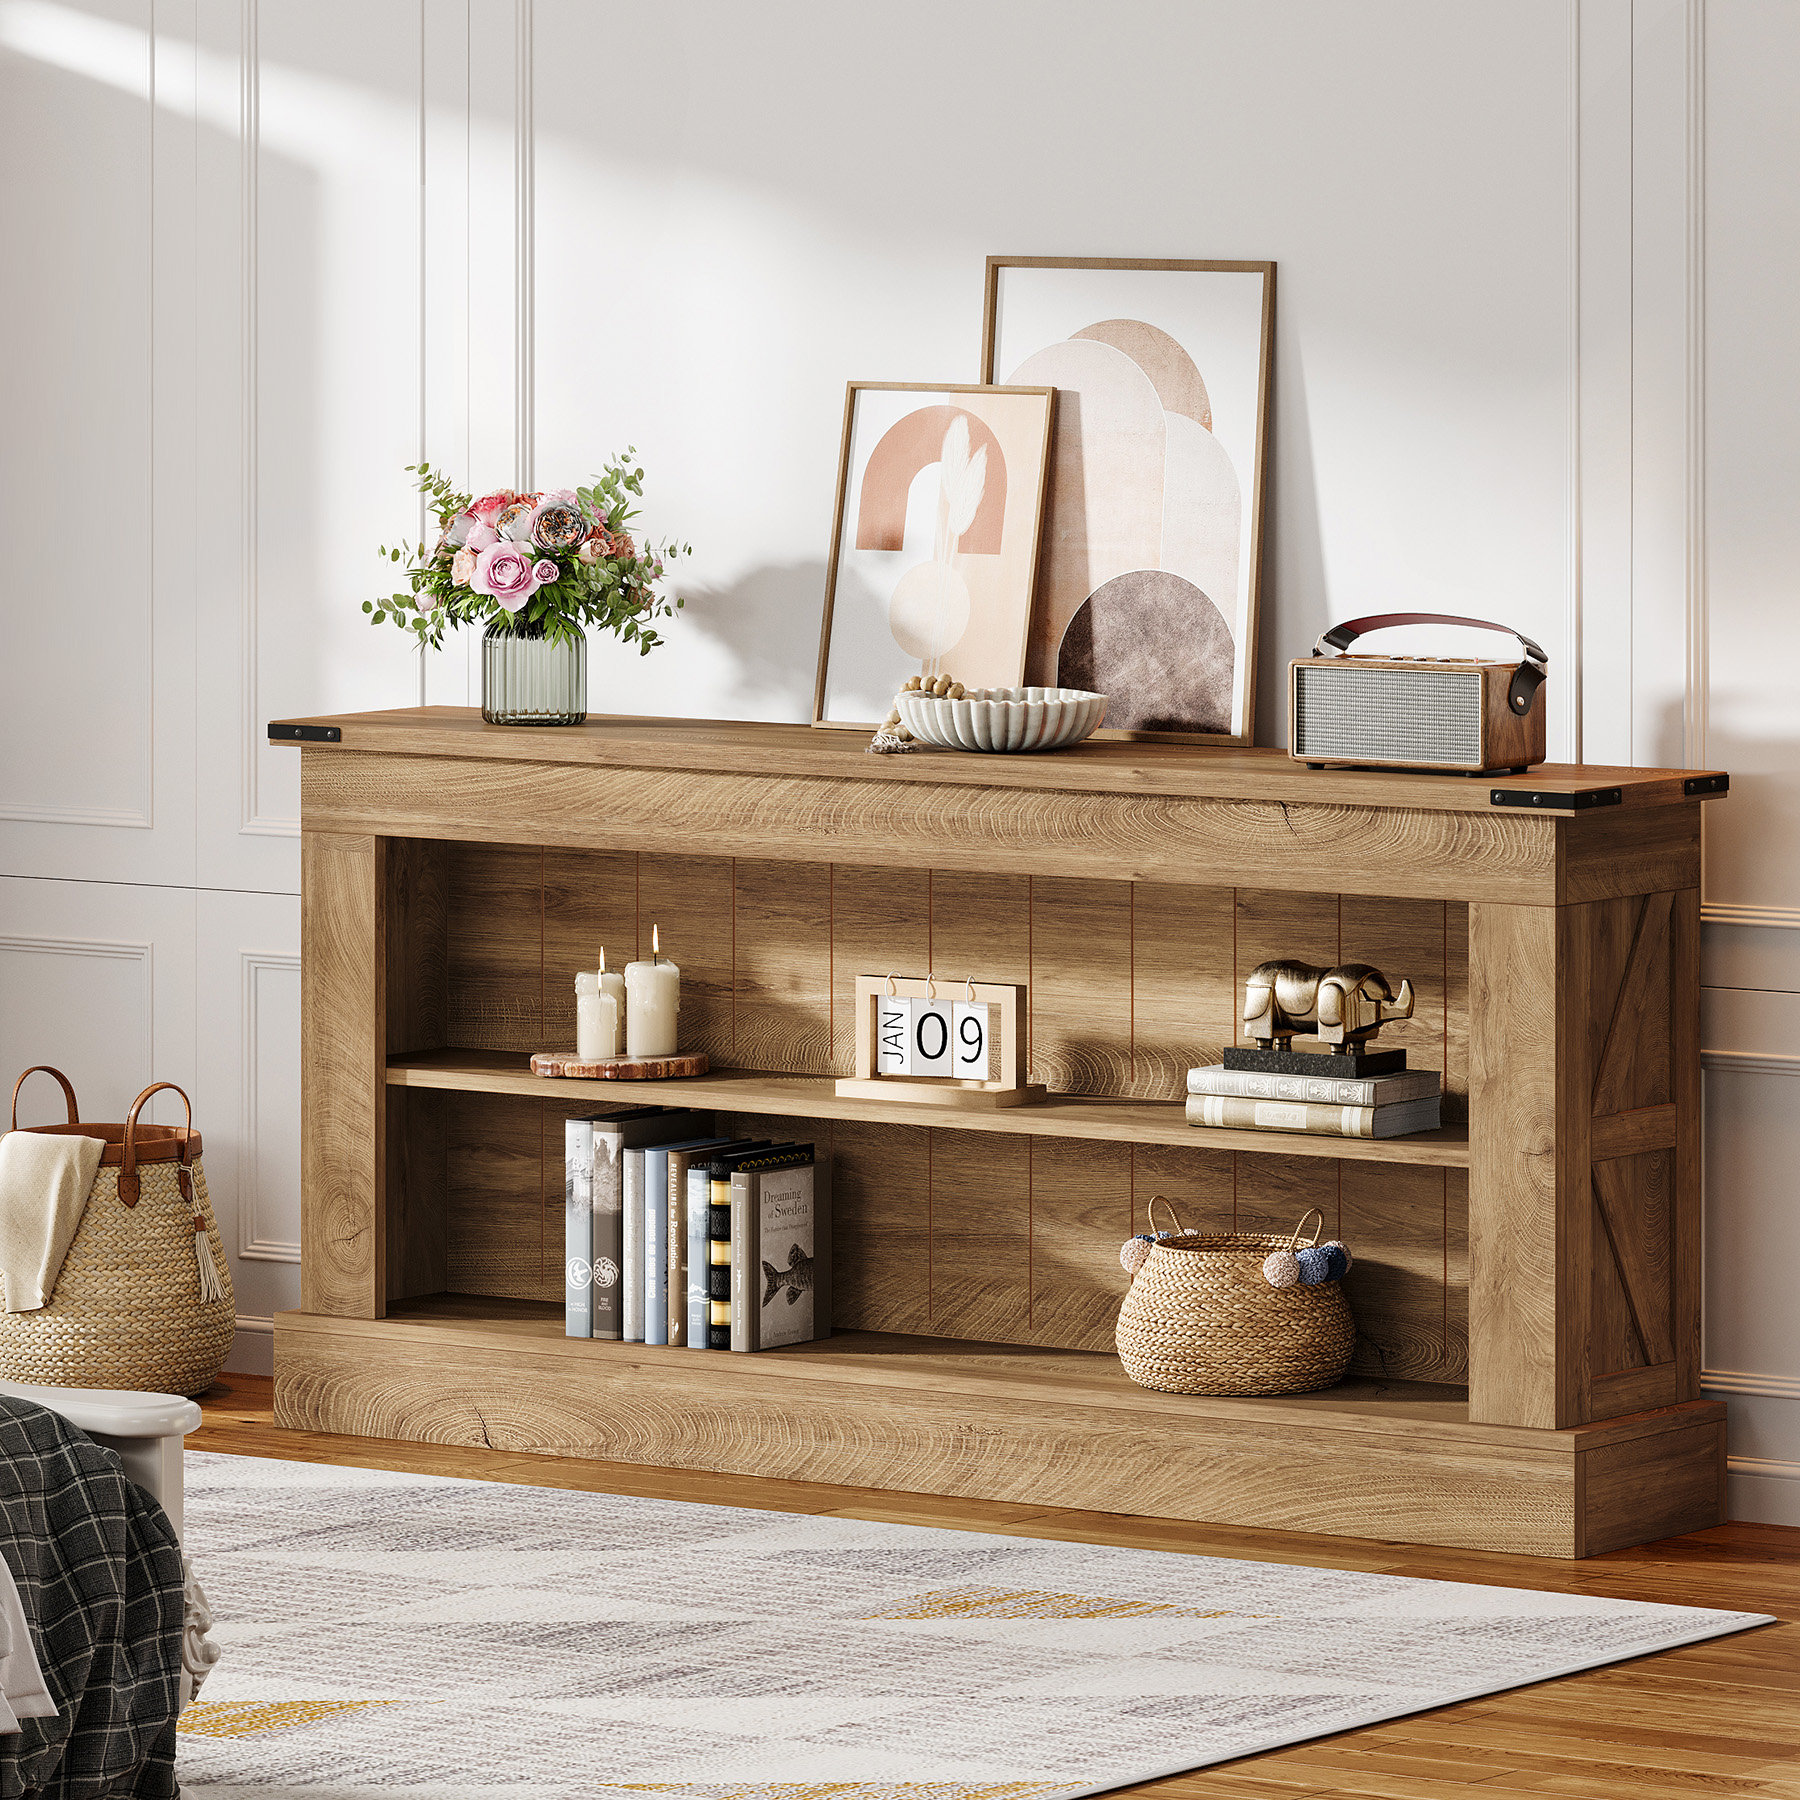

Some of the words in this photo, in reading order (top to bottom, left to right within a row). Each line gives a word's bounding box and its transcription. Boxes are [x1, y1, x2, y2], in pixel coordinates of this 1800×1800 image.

[882, 1011, 904, 1064] JAN
[764, 1187, 803, 1203] Dreaming
[767, 1209, 775, 1219] of
[775, 1200, 808, 1218] Sweden
[670, 1220, 679, 1270] Revolution
